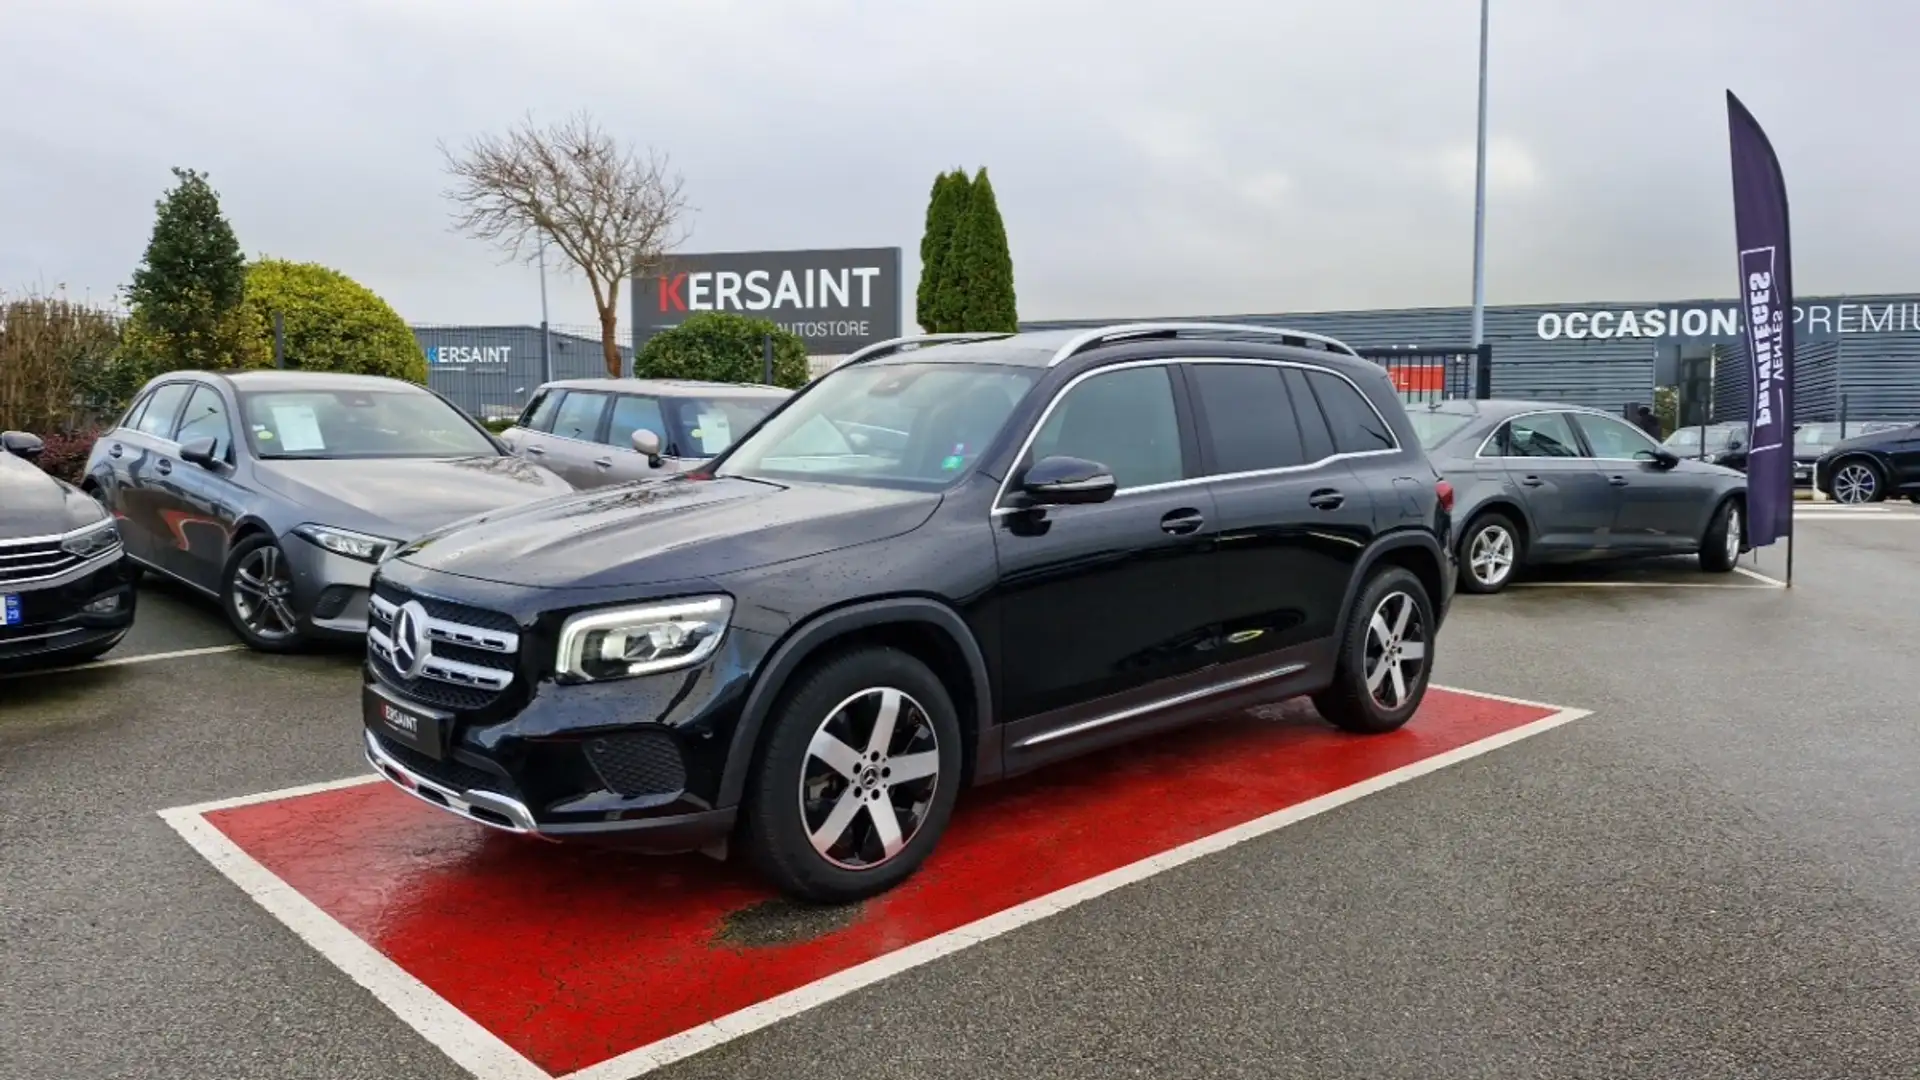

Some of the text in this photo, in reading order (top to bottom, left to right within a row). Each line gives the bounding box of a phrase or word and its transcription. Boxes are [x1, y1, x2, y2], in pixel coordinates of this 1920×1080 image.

[658, 267, 880, 312] KERSAINT
[1537, 307, 1745, 340] OCCASION
[427, 345, 511, 363] KERSAINT
